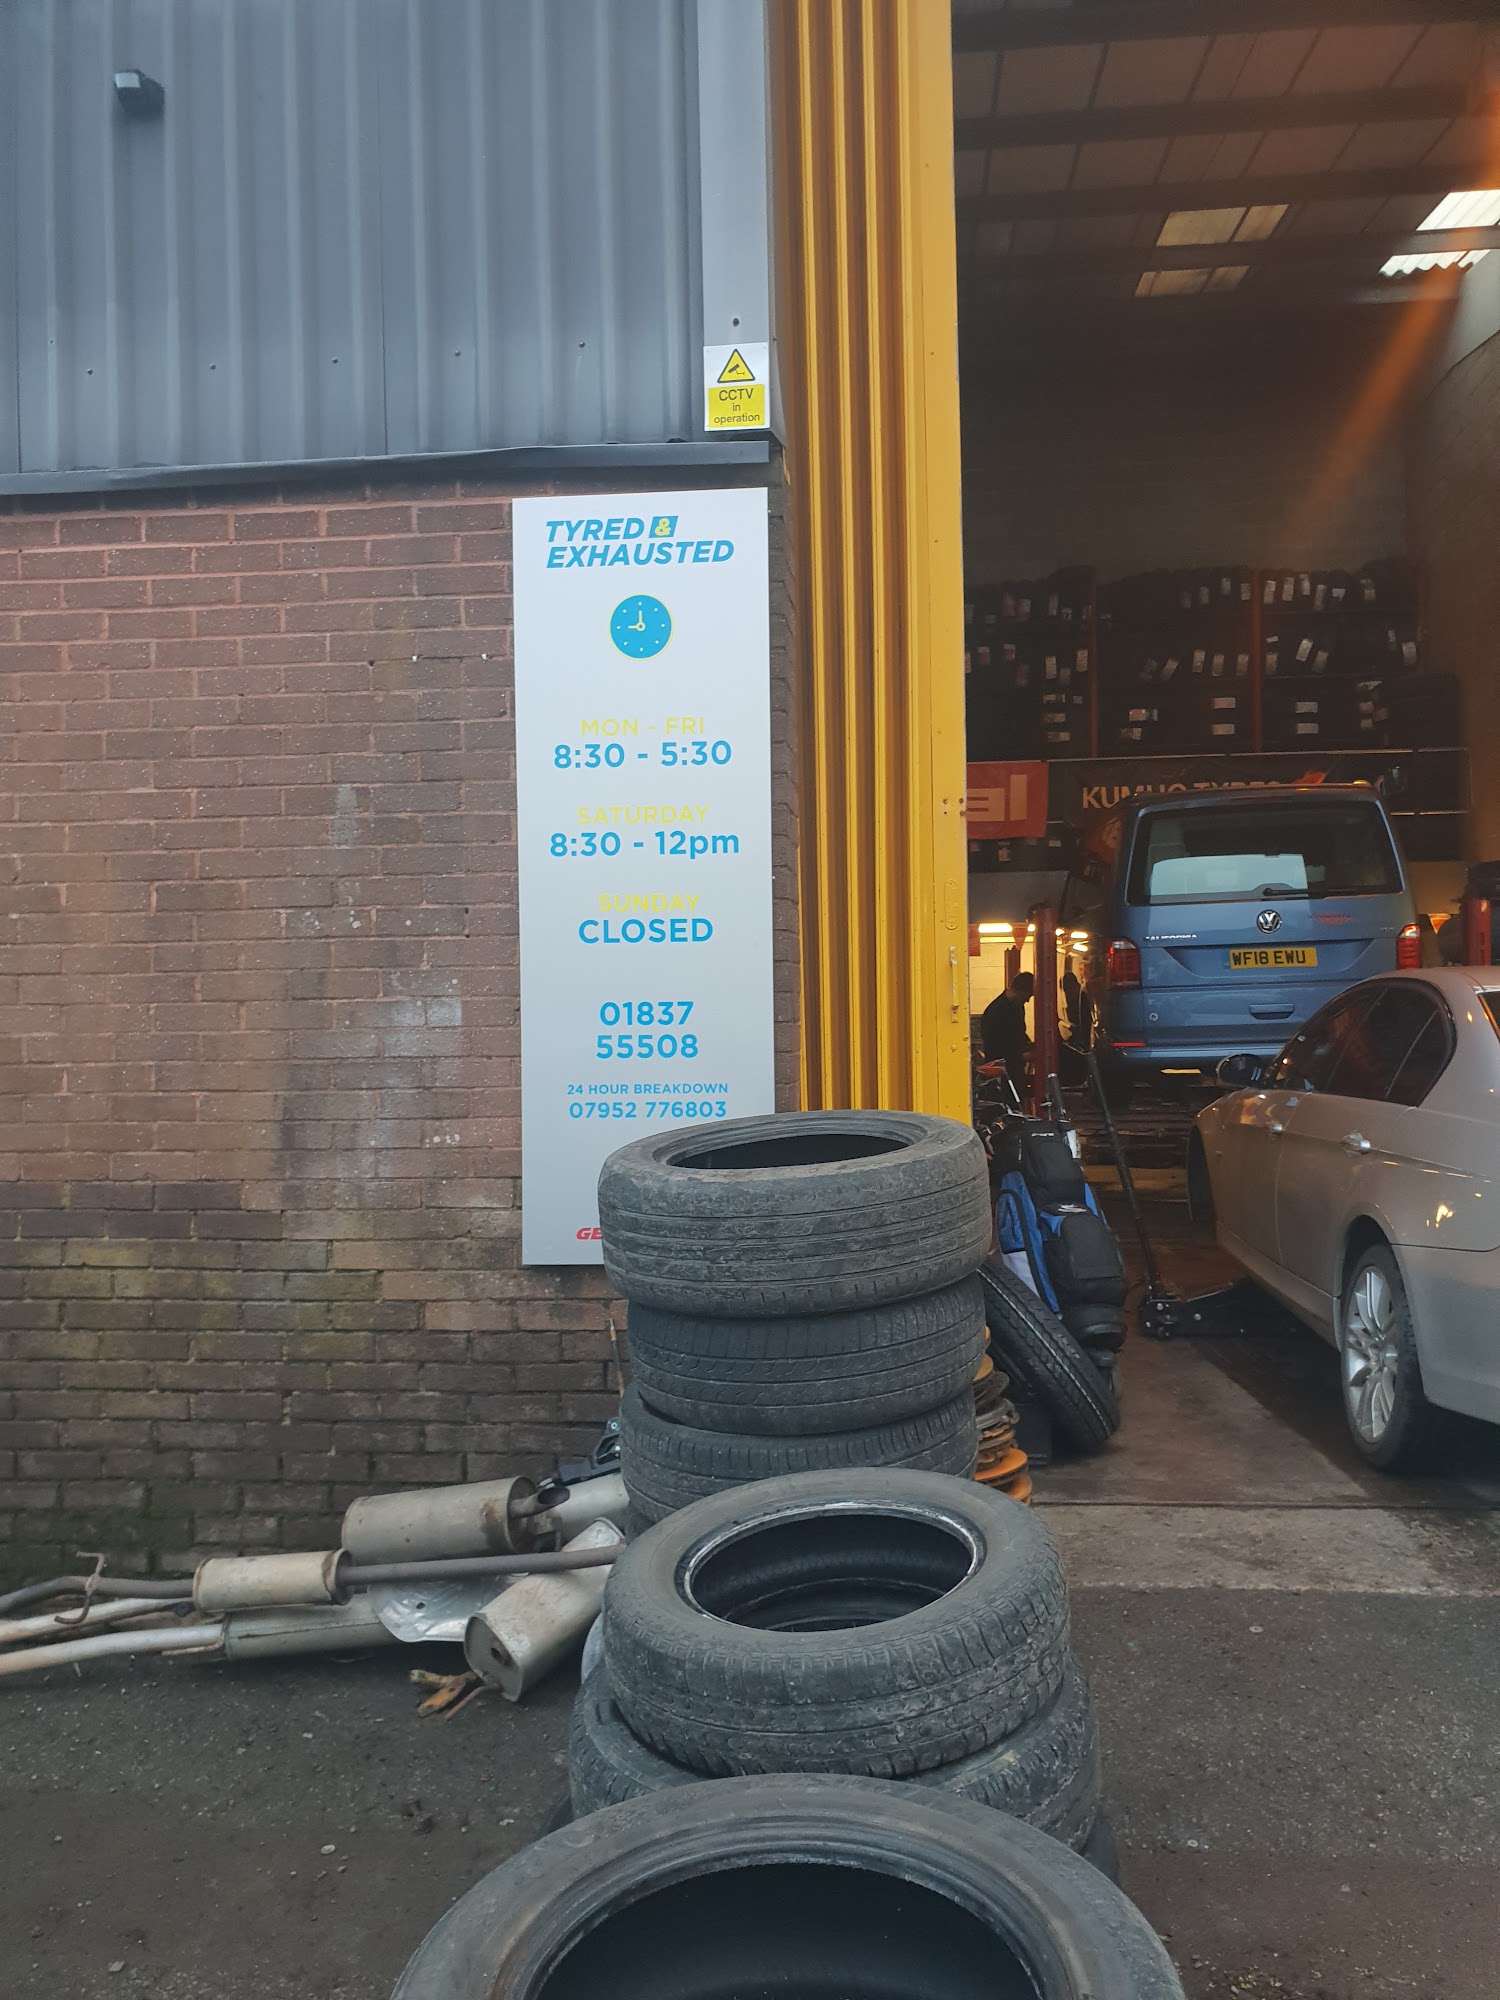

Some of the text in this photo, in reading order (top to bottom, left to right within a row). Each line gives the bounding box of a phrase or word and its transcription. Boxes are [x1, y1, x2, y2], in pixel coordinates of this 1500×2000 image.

[718, 388, 753, 401] CCTV
[732, 402, 740, 411] in
[713, 413, 760, 425] operation
[546, 517, 672, 542] TYRED &
[546, 540, 734, 568] EXHAUSTED
[580, 718, 639, 736] MON
[665, 716, 704, 735] FRI
[553, 743, 625, 769] 8:30
[660, 740, 732, 766] 5:30
[577, 805, 710, 825] SATURDAY
[549, 832, 621, 857] 8:30
[654, 830, 739, 860] 12pm
[598, 894, 701, 913] SUNDAY
[578, 918, 714, 944] CLOSED
[1232, 950, 1306, 966] WF18 EWU
[600, 1001, 694, 1026] 01837
[596, 1034, 699, 1059] 55508
[567, 1083, 728, 1095] 24 HOUR BREAKDOWN
[569, 1101, 727, 1119] 07952 776803
